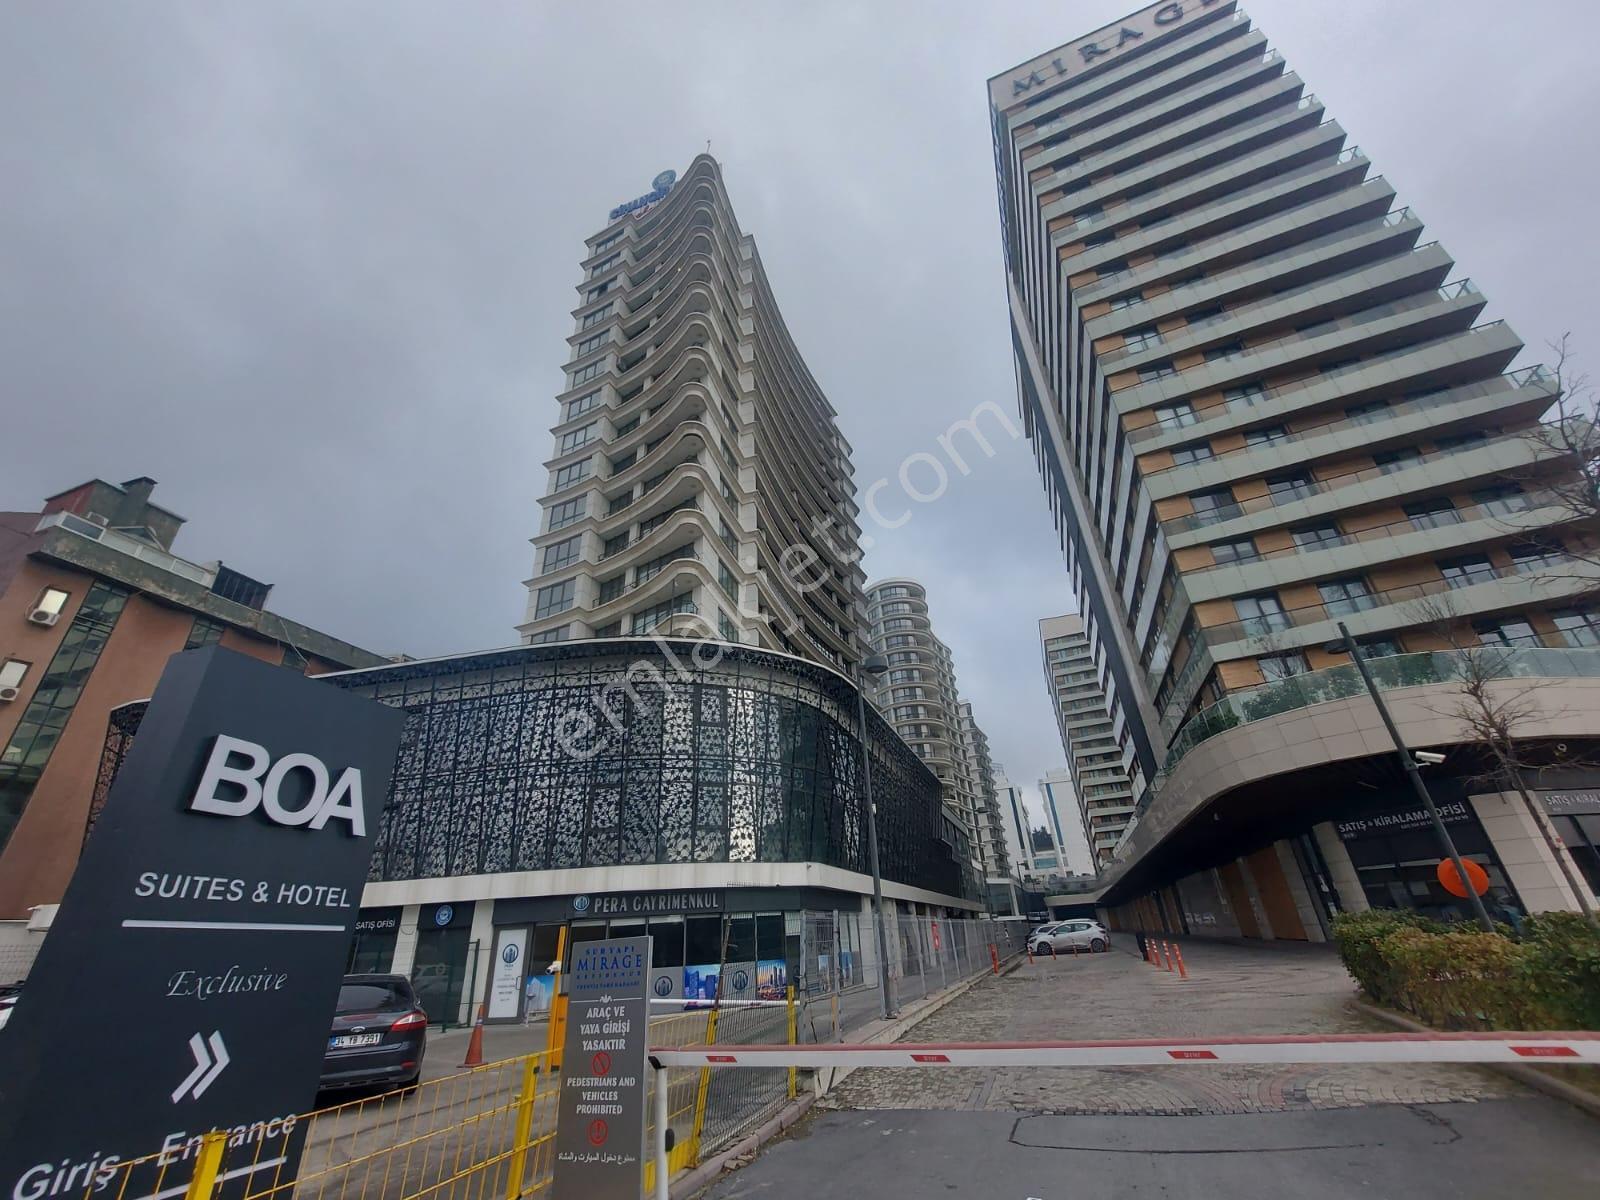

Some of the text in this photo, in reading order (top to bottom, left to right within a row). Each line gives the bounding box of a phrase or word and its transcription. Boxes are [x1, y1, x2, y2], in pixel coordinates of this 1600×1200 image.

[1012, 0, 1220, 96] MIRAG
[191, 734, 366, 837] BOA
[1338, 820, 1367, 833] SATIŞ
[1374, 809, 1431, 827] KİRALAMA
[135, 872, 350, 907] SUITES & HOTEL
[594, 898, 627, 913] PERA
[166, 965, 288, 1001] Exclusive
[586, 1006, 625, 1020] ARAÇ VE
[580, 1019, 630, 1036] YAYA GİRİŞİ
[582, 1039, 626, 1051] YASAKTIR
[567, 1076, 636, 1087] PEDESTRIANS AND
[582, 1091, 618, 1101] VEHICLES
[576, 1104, 623, 1115] PROHIBITED
[12, 1151, 121, 1200] Giriş
[157, 1114, 298, 1167] Enance
